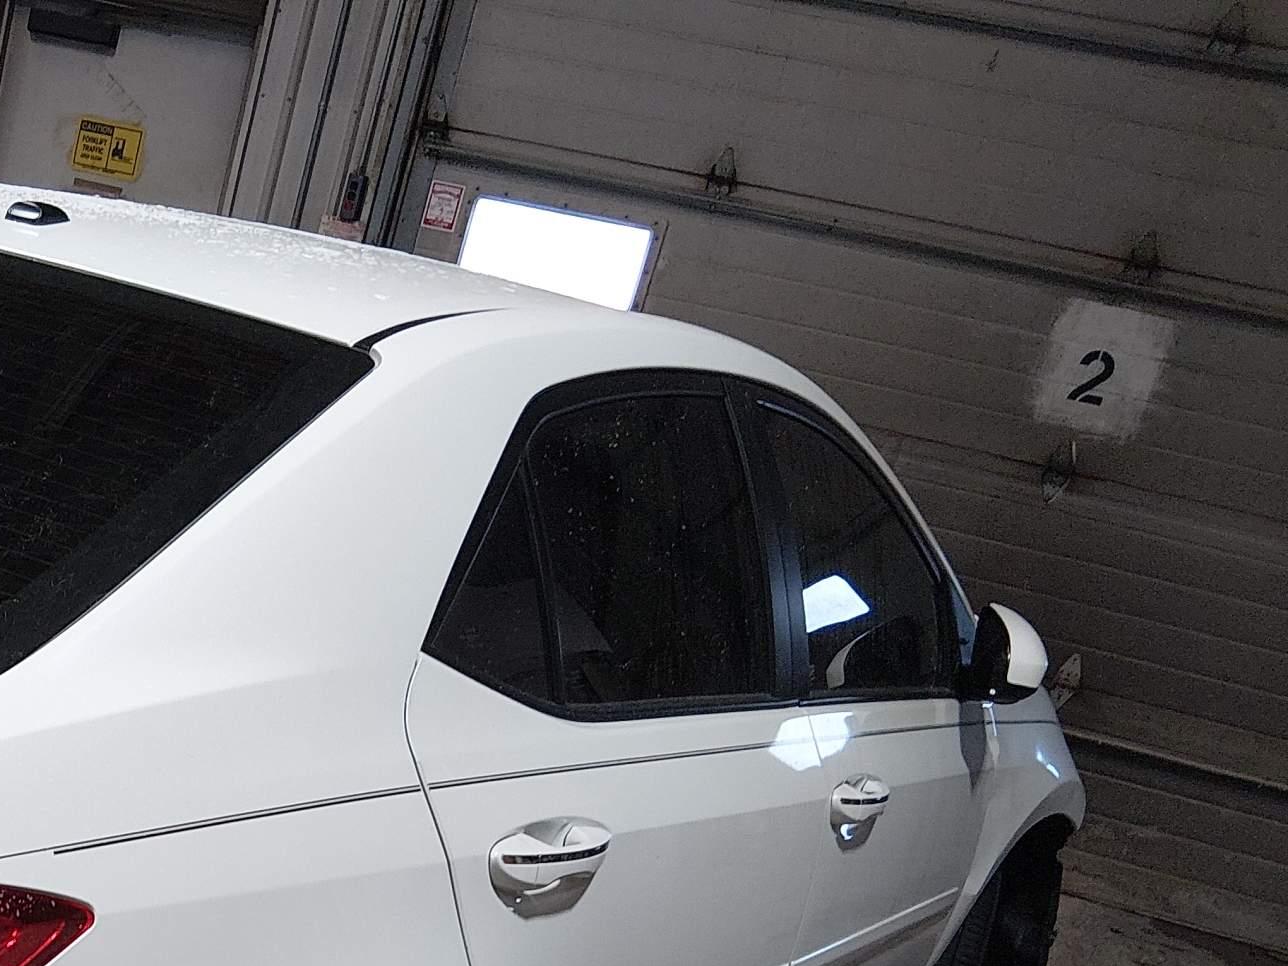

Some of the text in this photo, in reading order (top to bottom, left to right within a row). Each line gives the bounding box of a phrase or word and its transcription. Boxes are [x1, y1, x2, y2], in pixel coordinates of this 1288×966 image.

[81, 121, 113, 135] CAUTION
[82, 134, 108, 146] FORKLIFT
[82, 144, 104, 155] TRAFFIC
[1066, 350, 1115, 406] 2
